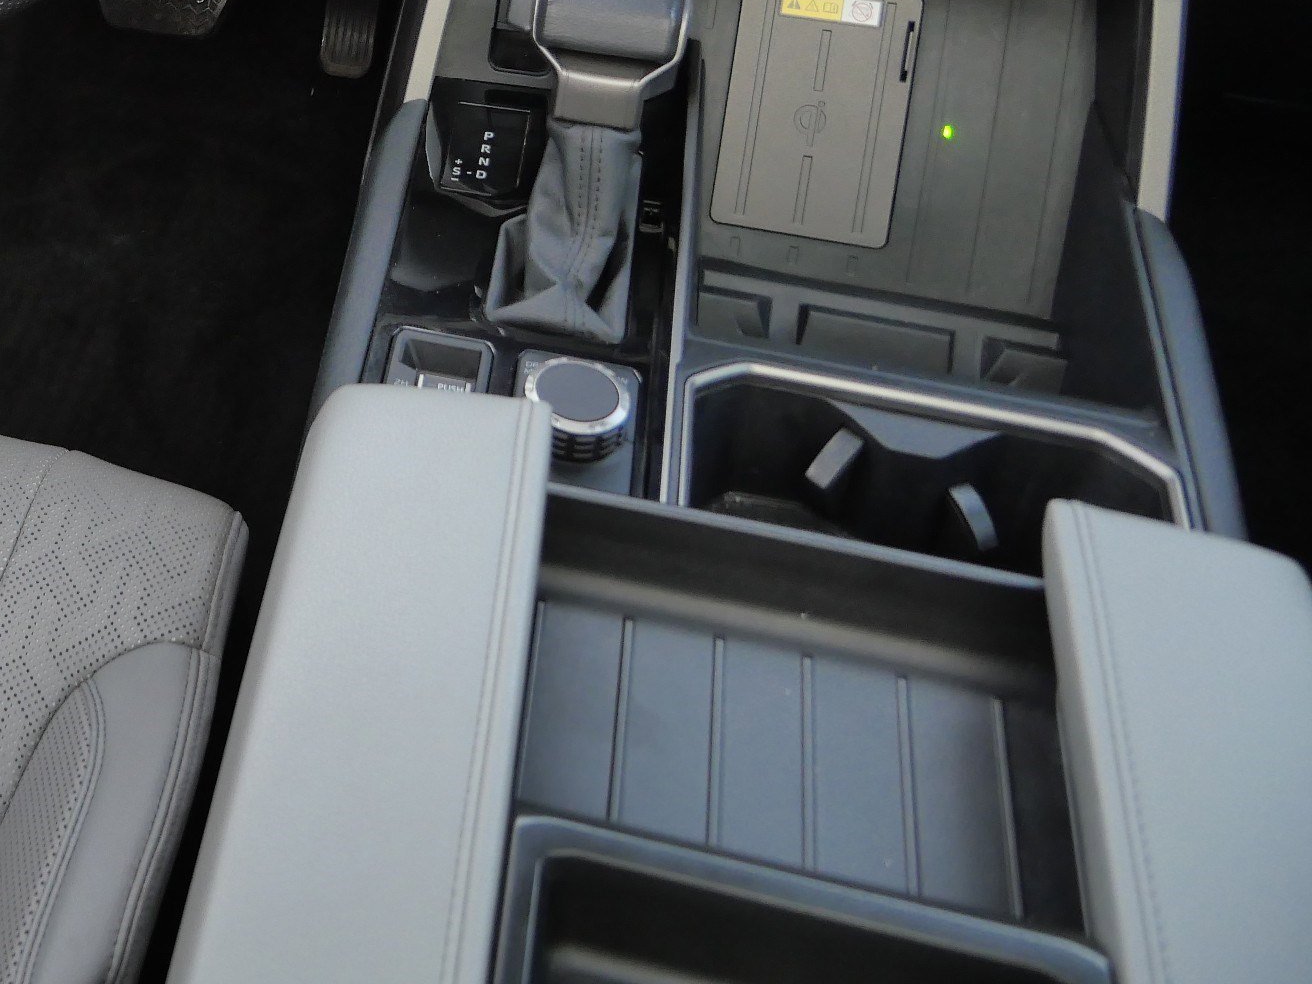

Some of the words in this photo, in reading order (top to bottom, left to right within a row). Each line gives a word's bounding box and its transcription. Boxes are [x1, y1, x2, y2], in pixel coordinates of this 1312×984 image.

[483, 131, 494, 141] P
[480, 144, 491, 154] R
[478, 157, 489, 166] N
[452, 167, 460, 175] S
[475, 170, 487, 179] D
[437, 382, 464, 393] PUSH
